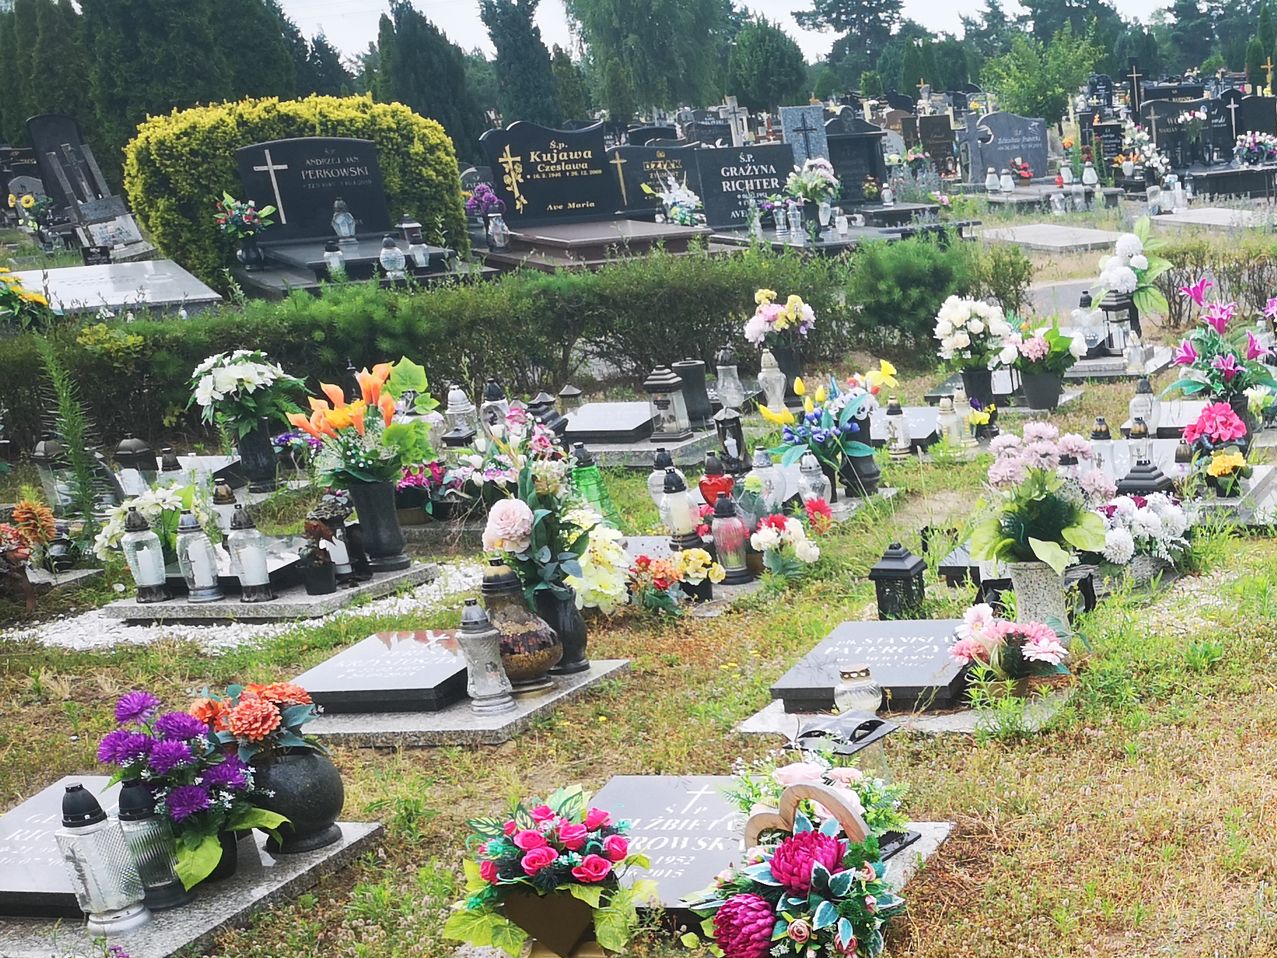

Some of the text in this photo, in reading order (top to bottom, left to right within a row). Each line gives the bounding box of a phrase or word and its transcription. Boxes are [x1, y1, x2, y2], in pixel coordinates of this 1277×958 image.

[529, 150, 592, 163] Kujawa
[720, 163, 776, 177] GRAŻYNA
[721, 178, 780, 192] RICHTER
[547, 201, 595, 211] Ave Maria
